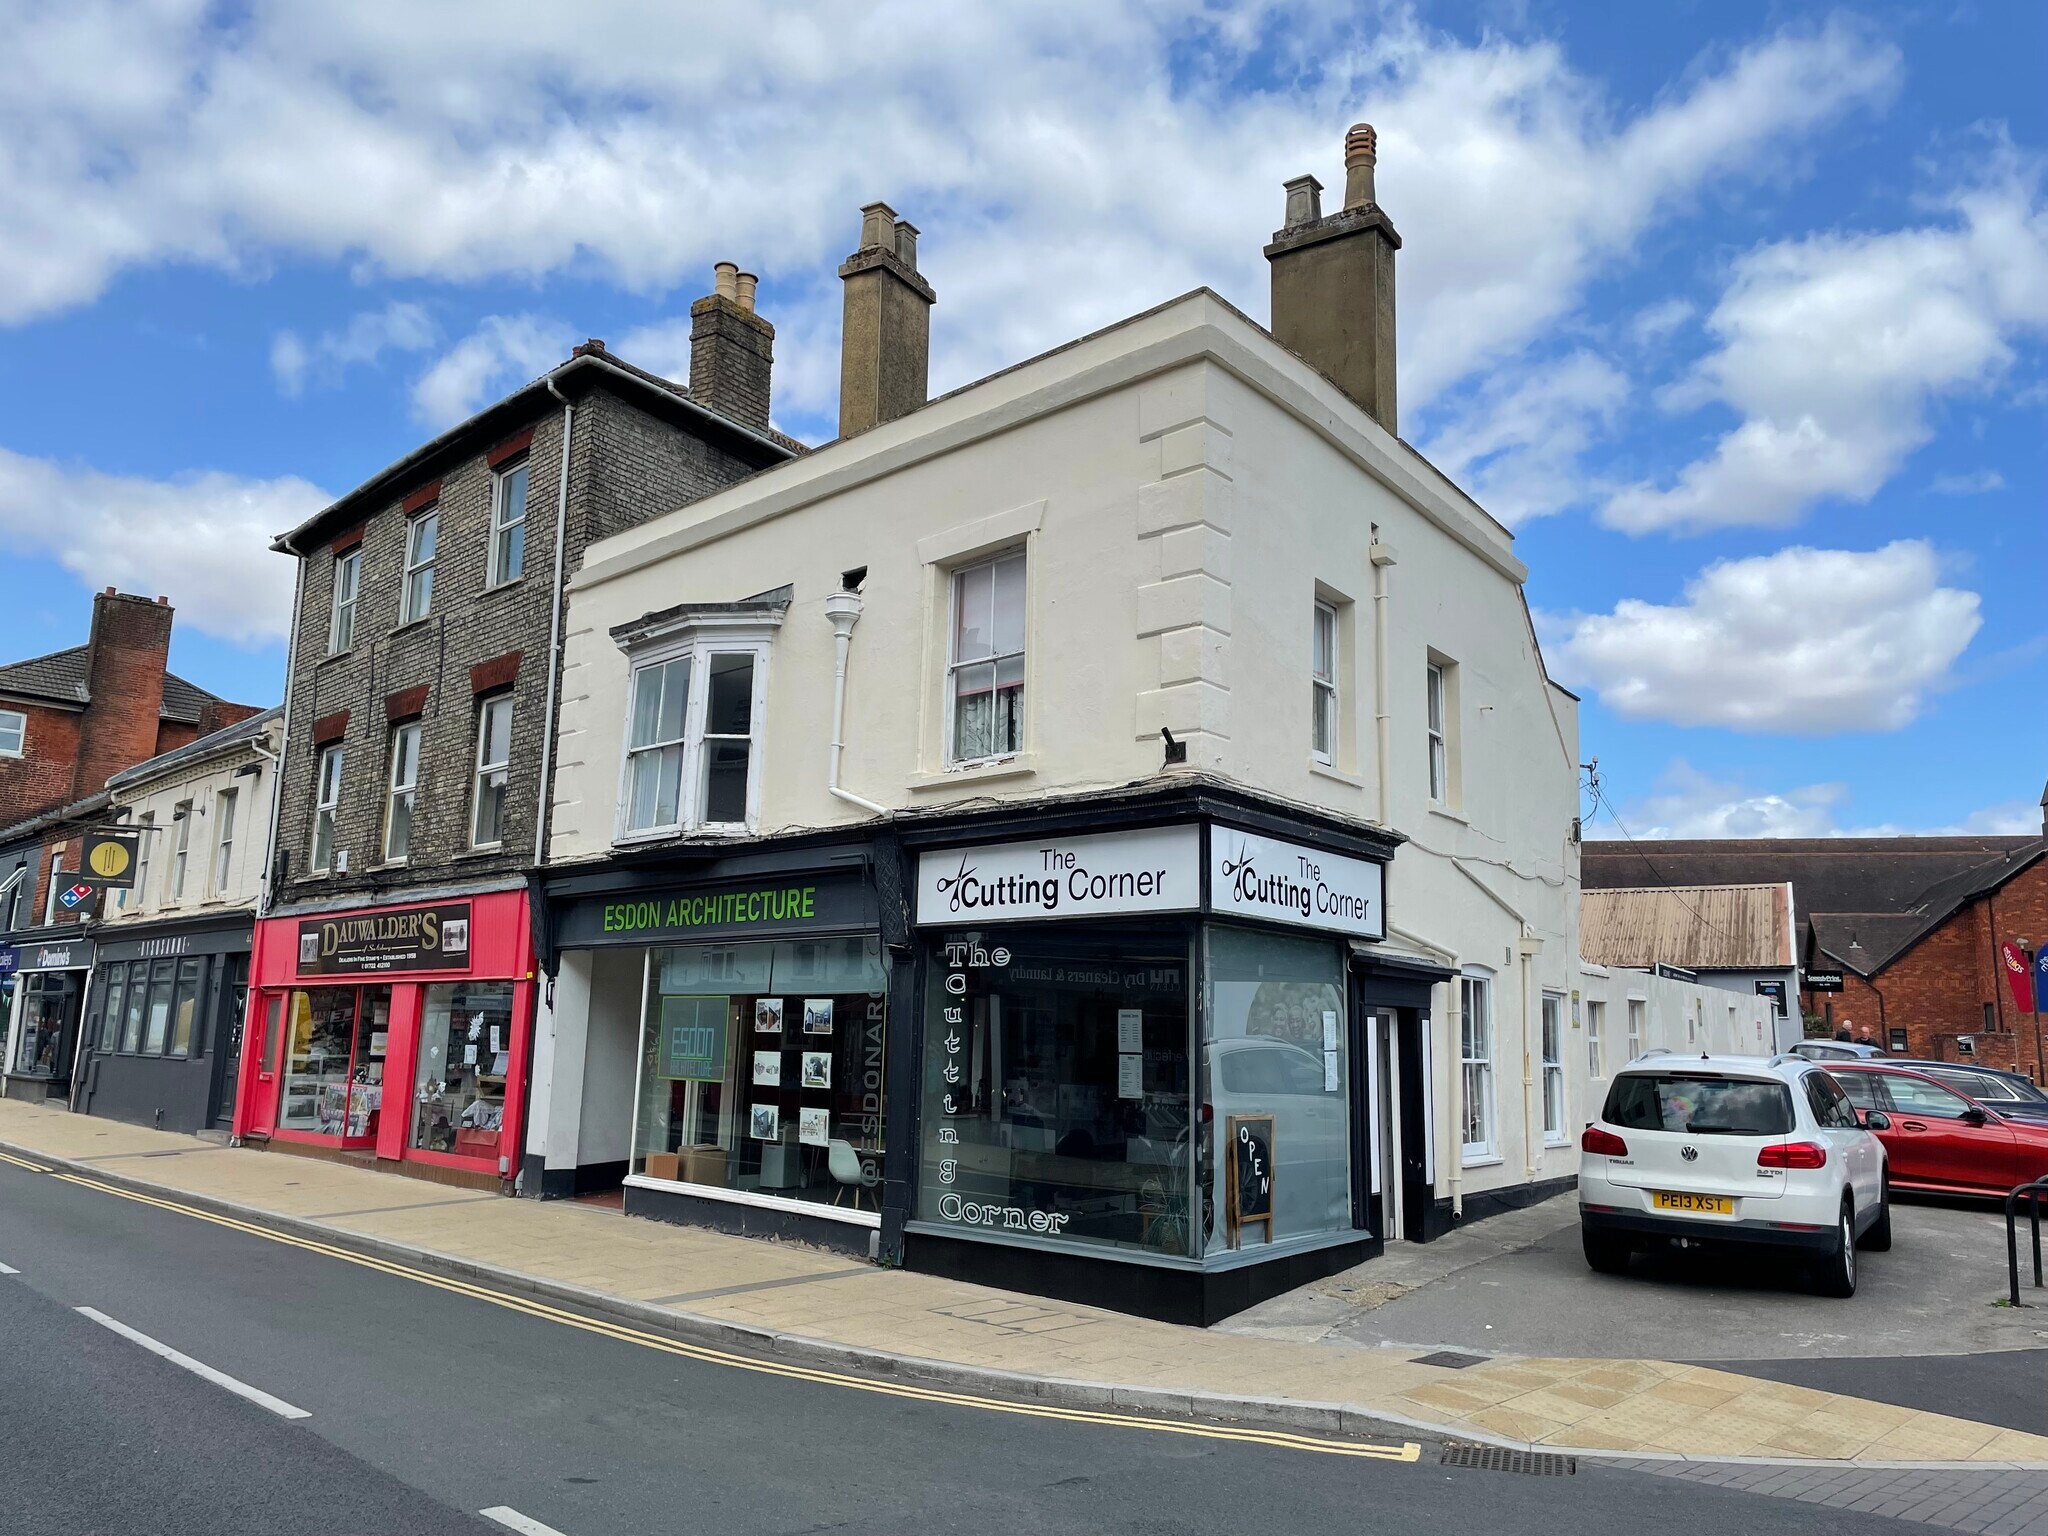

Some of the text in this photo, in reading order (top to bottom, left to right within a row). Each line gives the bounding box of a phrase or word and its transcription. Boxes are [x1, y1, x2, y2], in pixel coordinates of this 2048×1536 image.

[1040, 849, 1076, 871] The
[1297, 855, 1321, 881] The
[604, 887, 816, 932] ESDON ARCHITECTURE
[961, 868, 1166, 910] Cutting Corner
[1242, 866, 1369, 921] Cutting Corner
[321, 912, 439, 956] DAUWALDER'S
[945, 940, 1011, 967] The
[42, 946, 71, 967] Domino's
[1240, 1126, 1270, 1195] OPEN
[939, 1193, 1069, 1235] Corner
[1661, 1193, 1723, 1211] PE13 XST
